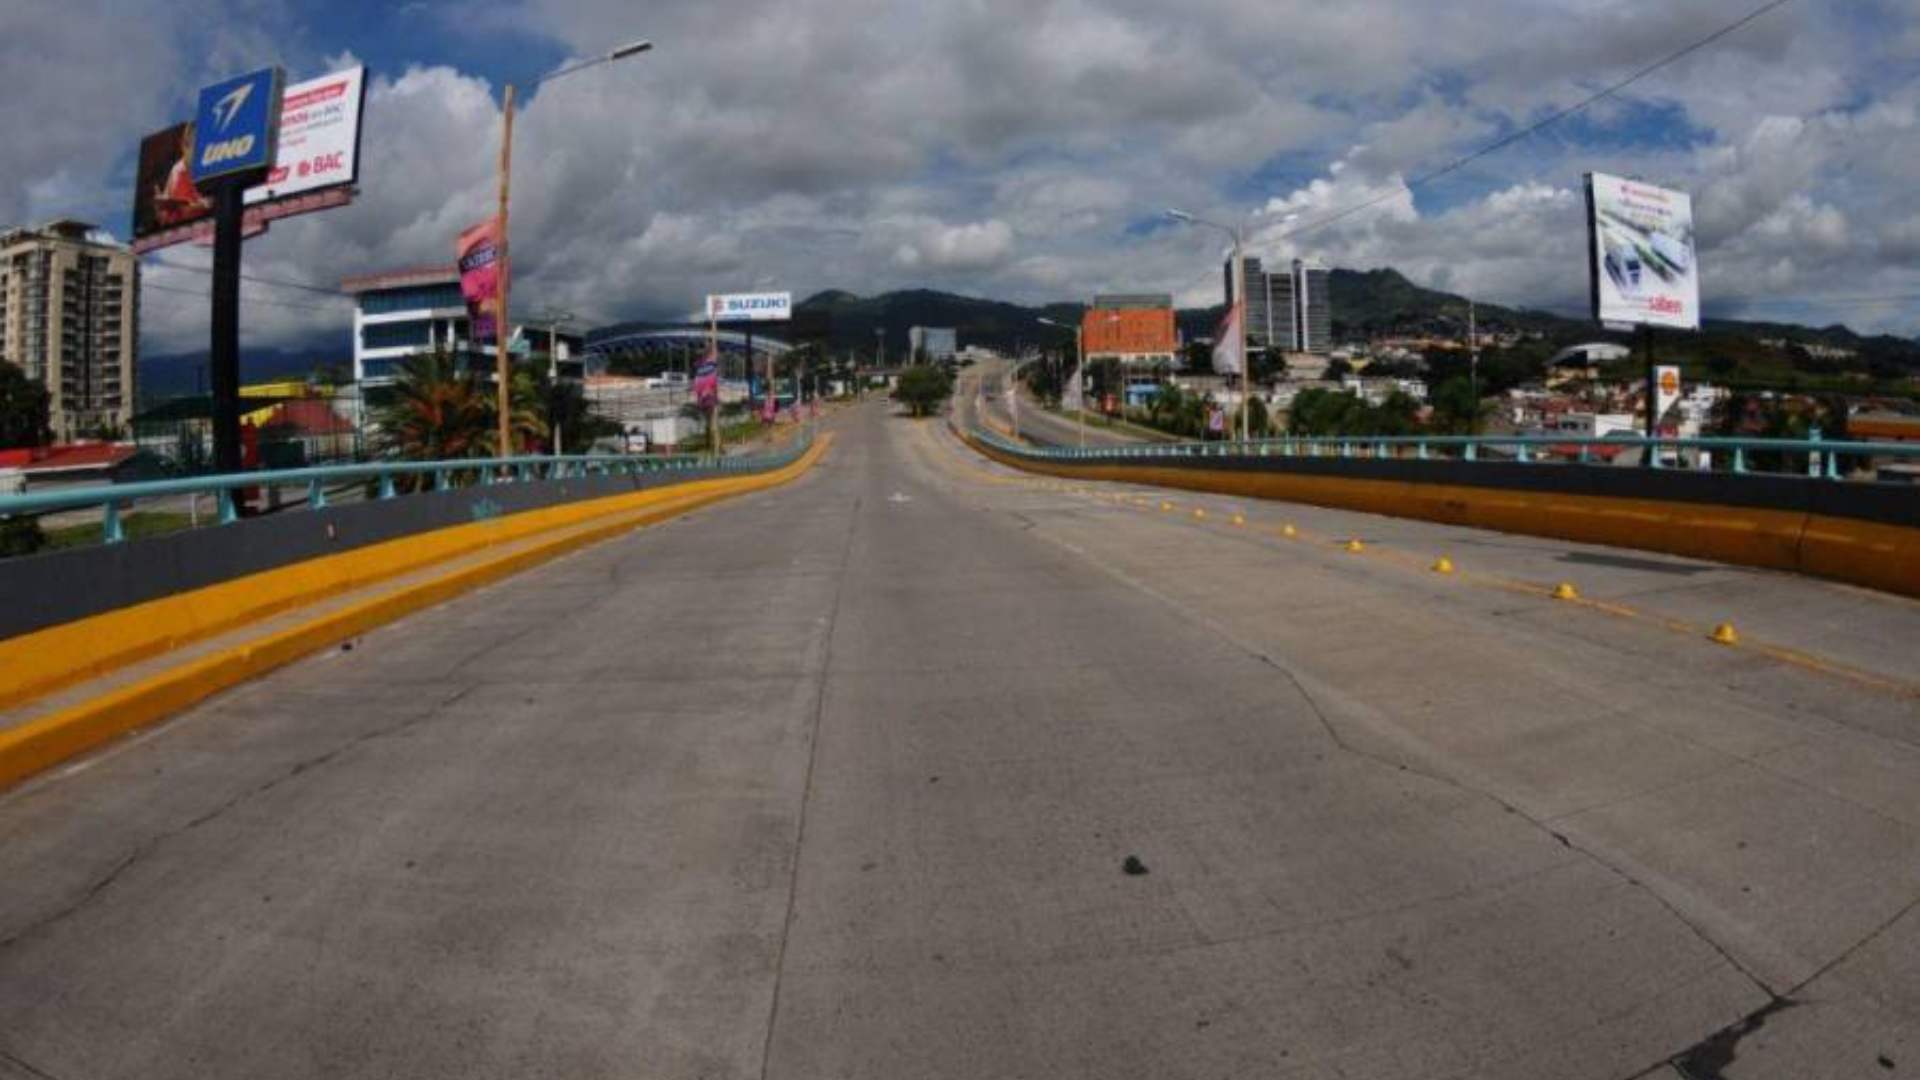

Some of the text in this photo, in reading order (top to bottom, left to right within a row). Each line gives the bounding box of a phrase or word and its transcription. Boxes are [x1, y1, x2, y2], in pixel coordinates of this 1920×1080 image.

[202, 134, 255, 166] UNO
[313, 152, 343, 174] BAC
[728, 298, 786, 310] SUZUKI
